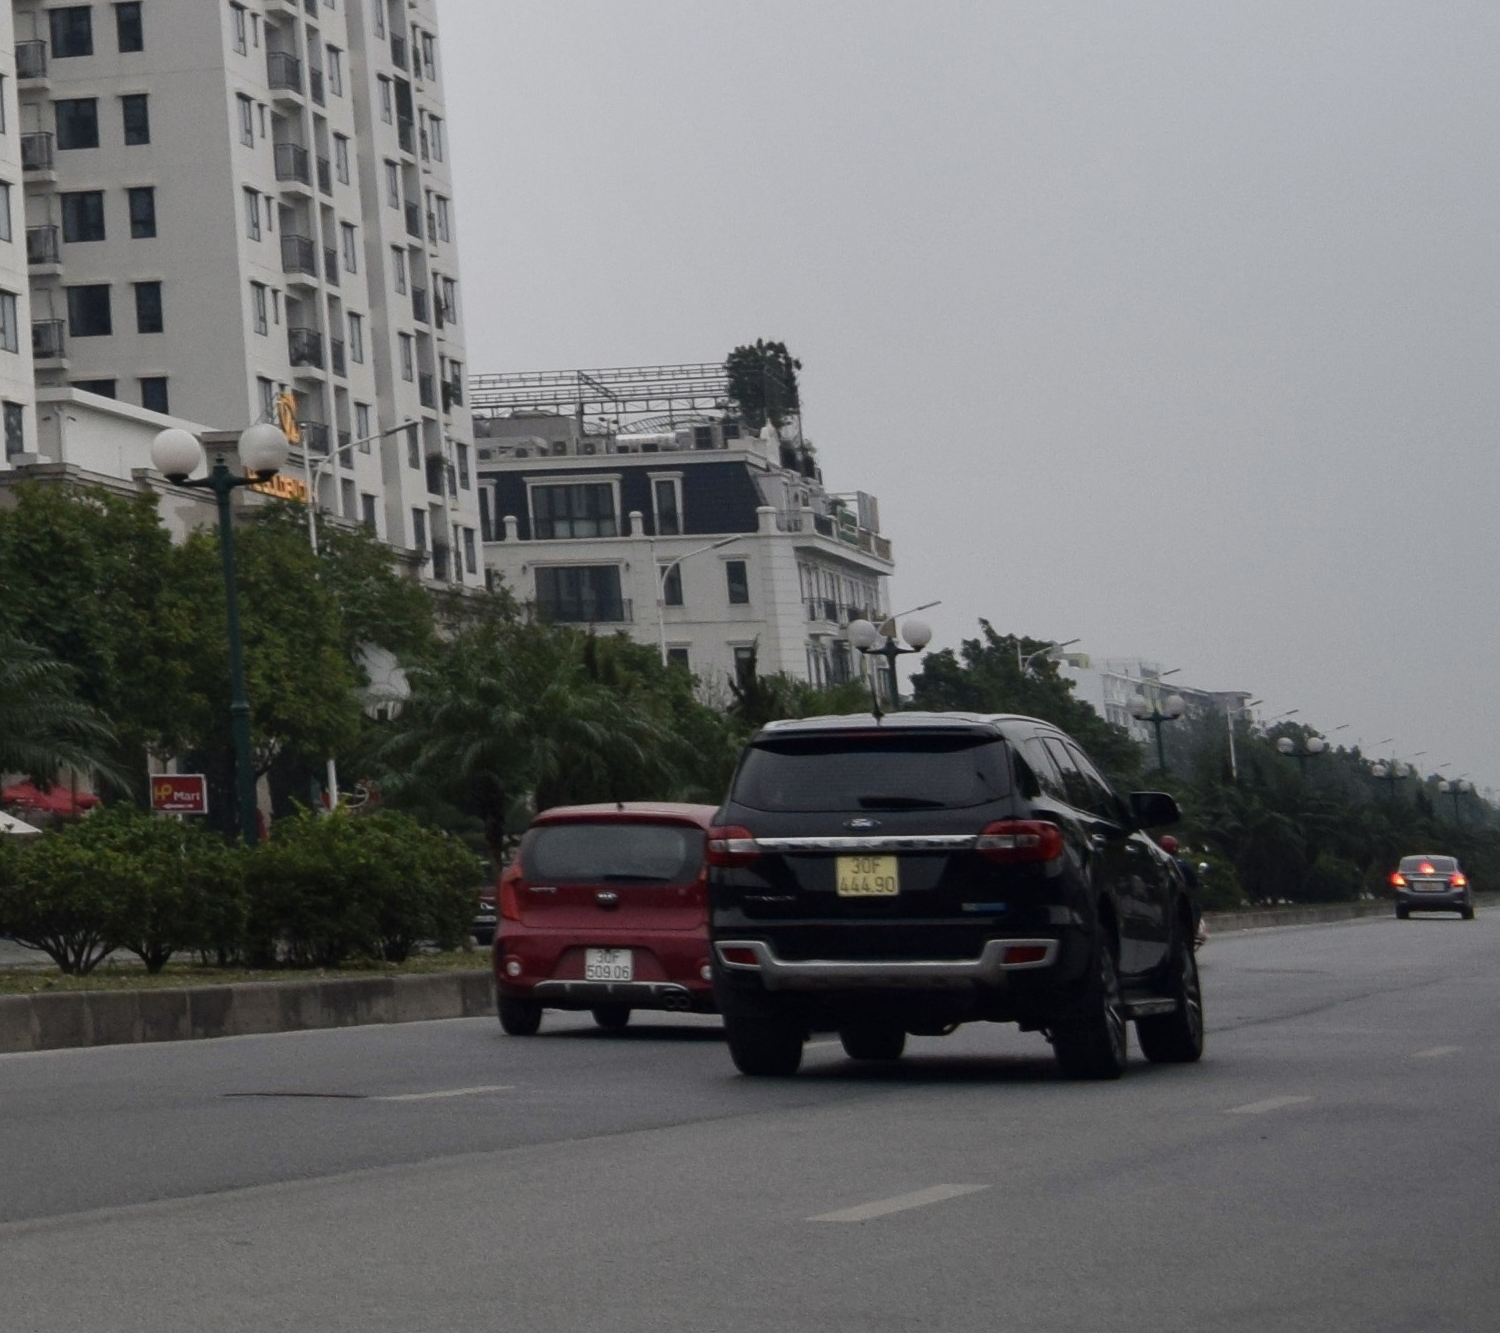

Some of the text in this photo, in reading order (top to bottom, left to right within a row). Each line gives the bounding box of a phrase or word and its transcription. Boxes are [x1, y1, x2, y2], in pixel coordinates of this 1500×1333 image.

[173, 791, 200, 801] Mart
[851, 856, 882, 874] 30F
[840, 875, 896, 893] 444.90
[595, 949, 621, 964] 30F
[587, 964, 630, 980] 509.06
